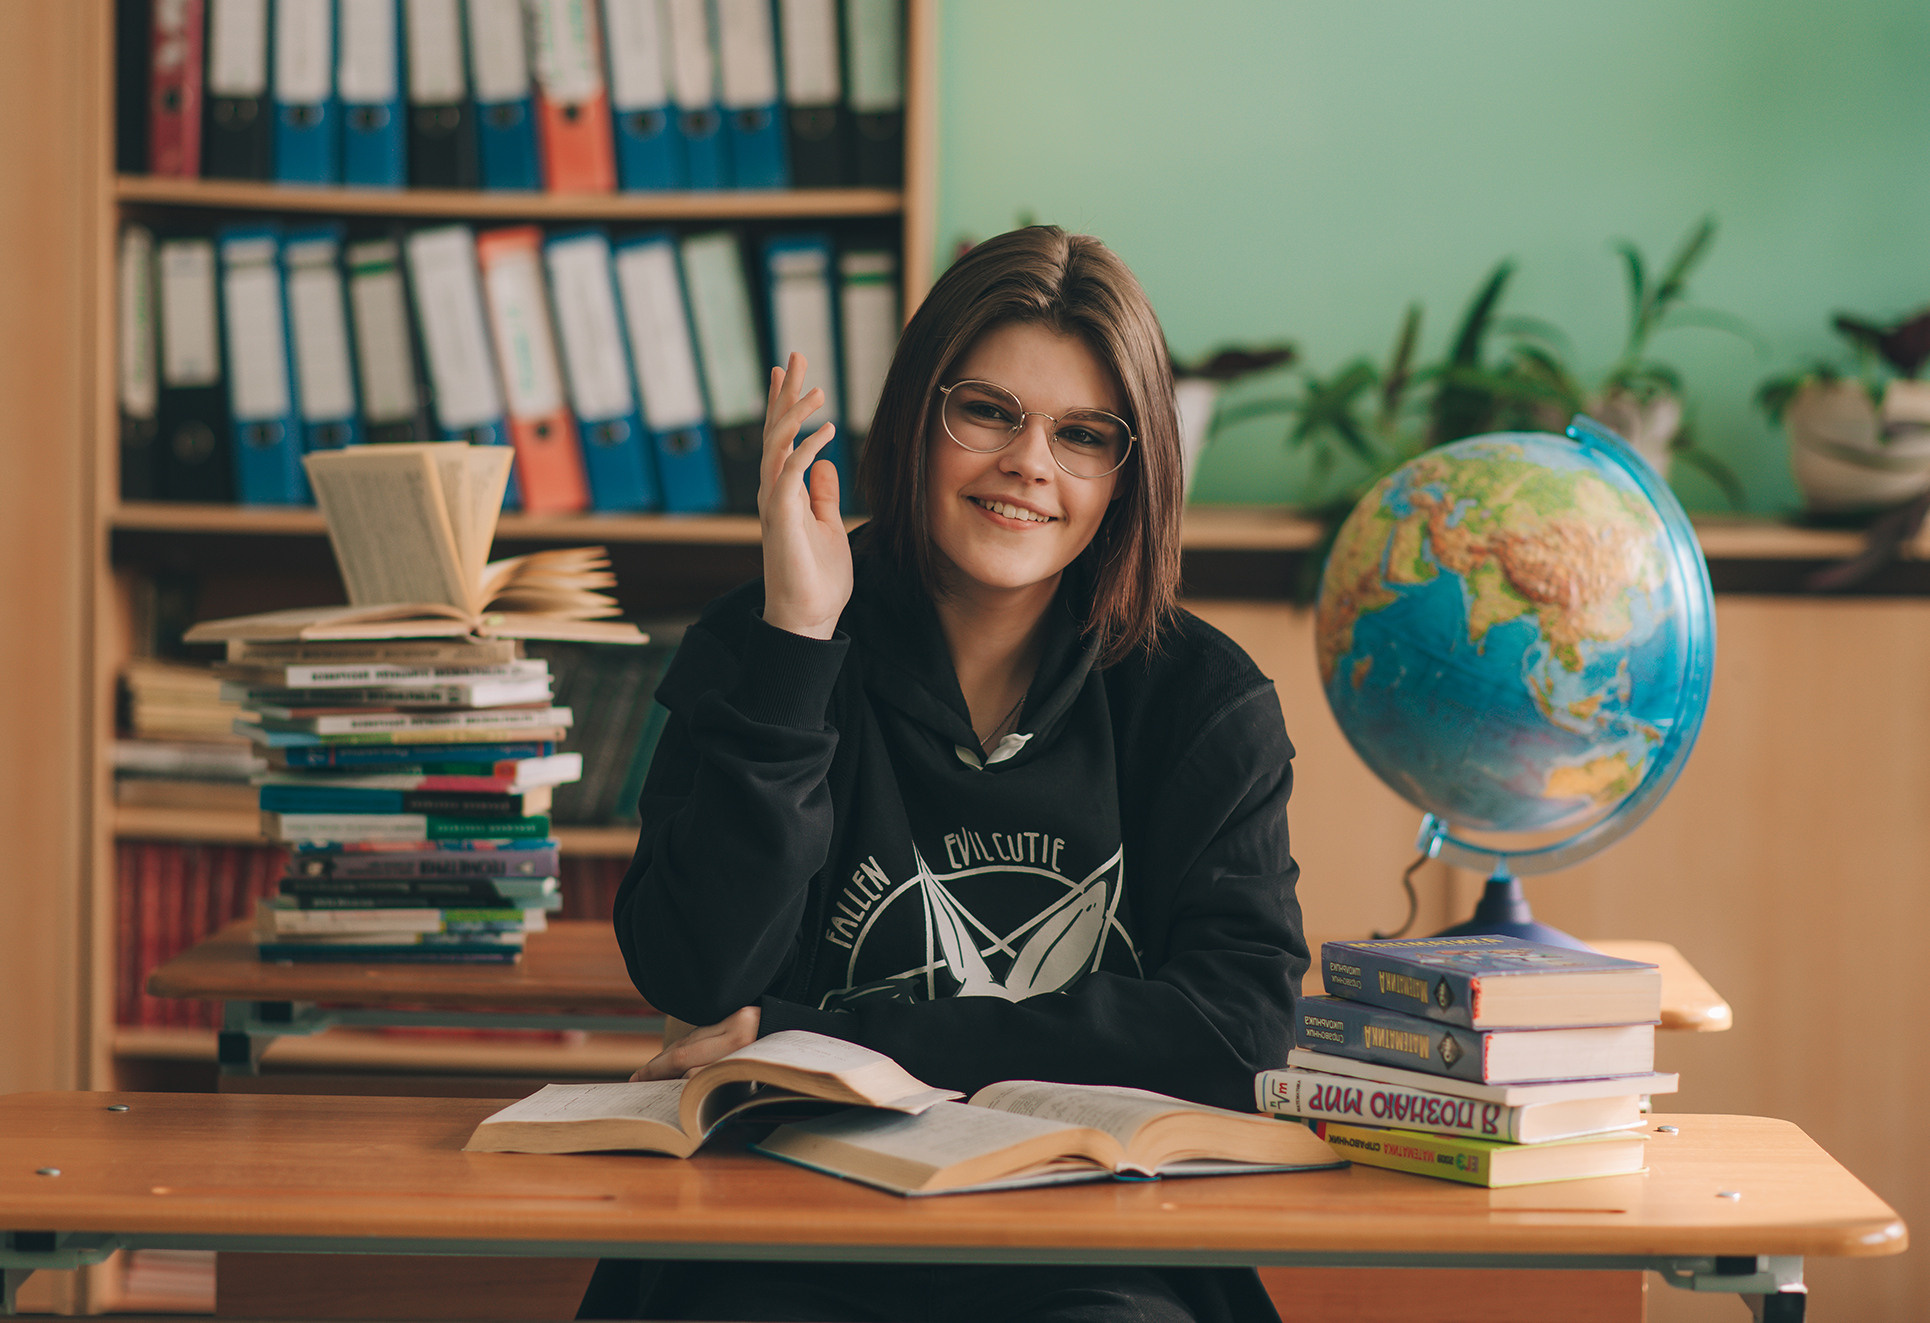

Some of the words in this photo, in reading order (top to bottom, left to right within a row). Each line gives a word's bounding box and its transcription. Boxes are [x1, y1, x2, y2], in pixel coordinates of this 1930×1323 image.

[825, 855, 891, 949] FALLEN
[944, 827, 994, 869] EVIL
[992, 832, 1065, 873] CUTIE
[1308, 1083, 1364, 1116] МИР
[1369, 1090, 1476, 1130] ПОЗНАЮ
[1481, 1104, 1501, 1135] Я
[1328, 1134, 1381, 1152] СПРАВОЧНИК
[1384, 1143, 1435, 1164] МАТЕМАТИКА
[1455, 1152, 1479, 1173] ЕГЭ
